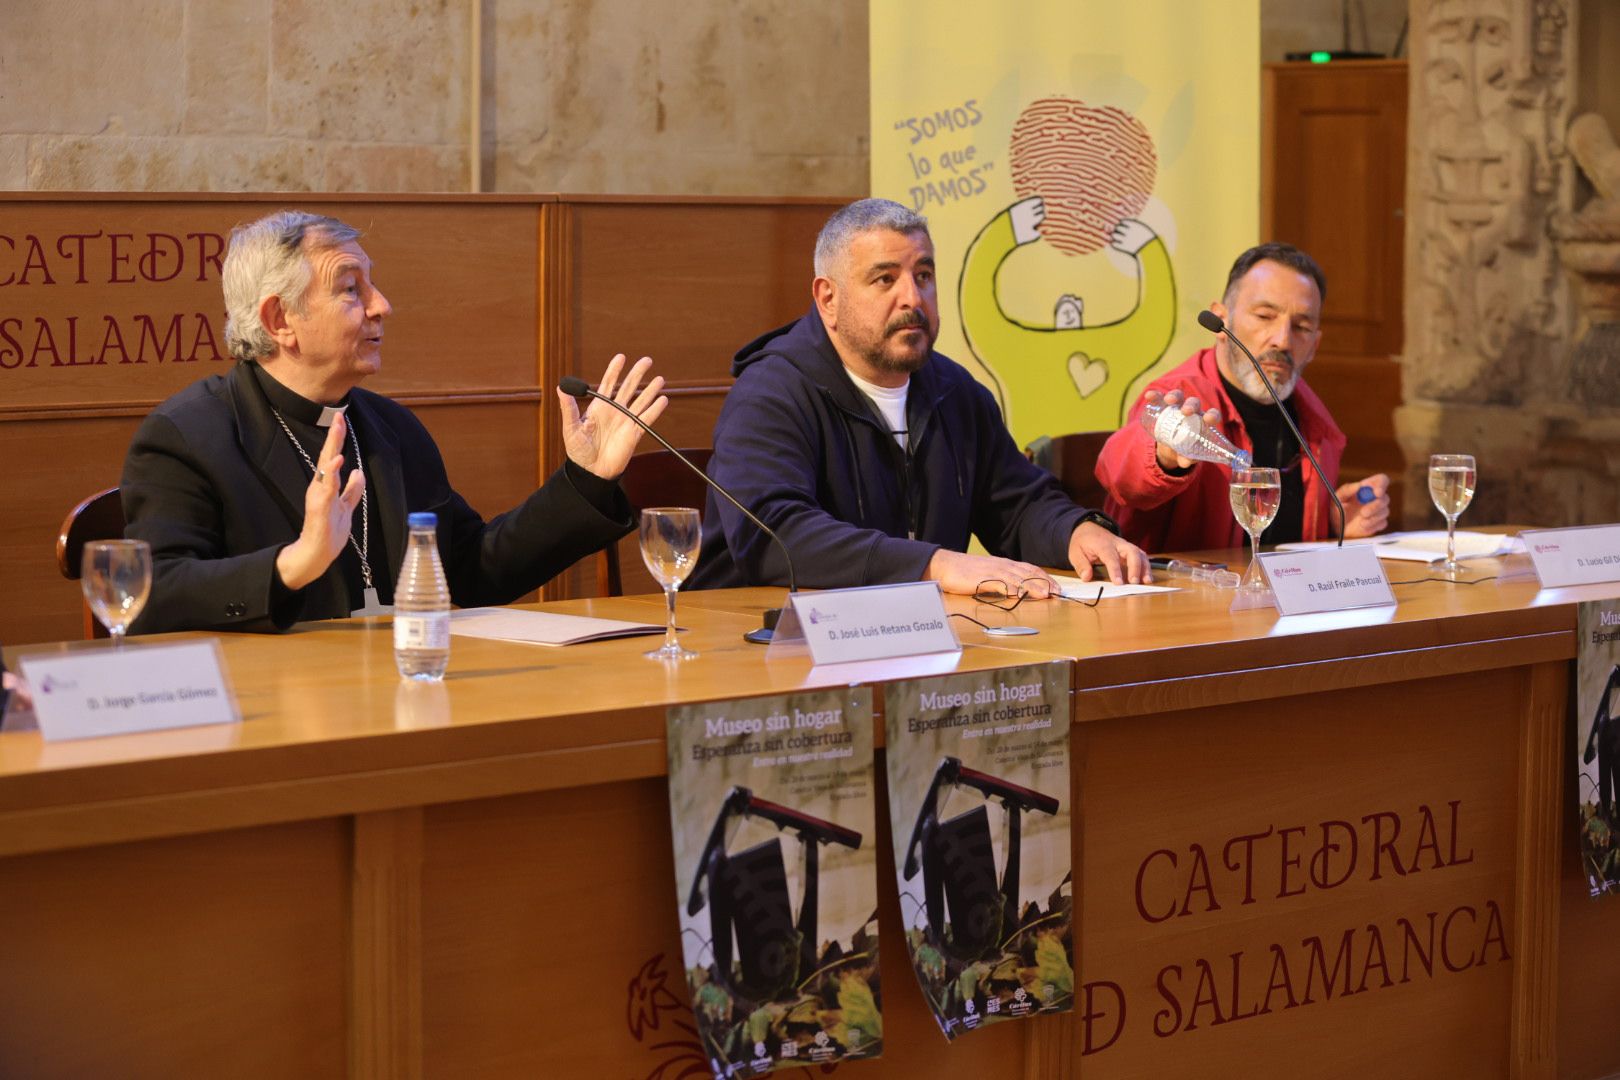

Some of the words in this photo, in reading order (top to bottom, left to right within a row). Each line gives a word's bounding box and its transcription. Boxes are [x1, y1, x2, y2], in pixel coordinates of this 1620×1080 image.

[908, 152, 932, 180] lo
[939, 145, 976, 174] que
[0, 313, 235, 369] SALAMA
[1308, 584, 1317, 592] D.
[1318, 581, 1334, 591] Raúl
[1335, 579, 1355, 589] Fraile
[1356, 576, 1382, 587] Pascual
[829, 630, 839, 640] D.
[841, 627, 860, 640] José
[862, 625, 880, 637] Luis
[880, 623, 911, 636] Retana
[913, 620, 944, 632] Gozalo
[920, 692, 971, 712] Museo
[974, 686, 996, 704] sin
[1000, 681, 1042, 701] hogar
[704, 716, 761, 739] Museo
[765, 711, 790, 731] sin
[794, 708, 842, 730] hogar
[908, 713, 970, 735] Esperanza
[972, 710, 990, 725] sin
[993, 703, 1053, 722] cobertura
[1022, 718, 1052, 731] realidad
[692, 737, 761, 761] Esperanza
[764, 734, 784, 752] sin
[787, 730, 853, 750] cobertura
[1134, 800, 1475, 924] CATEDRAL
[1152, 900, 1512, 1038] SALAMANCA
